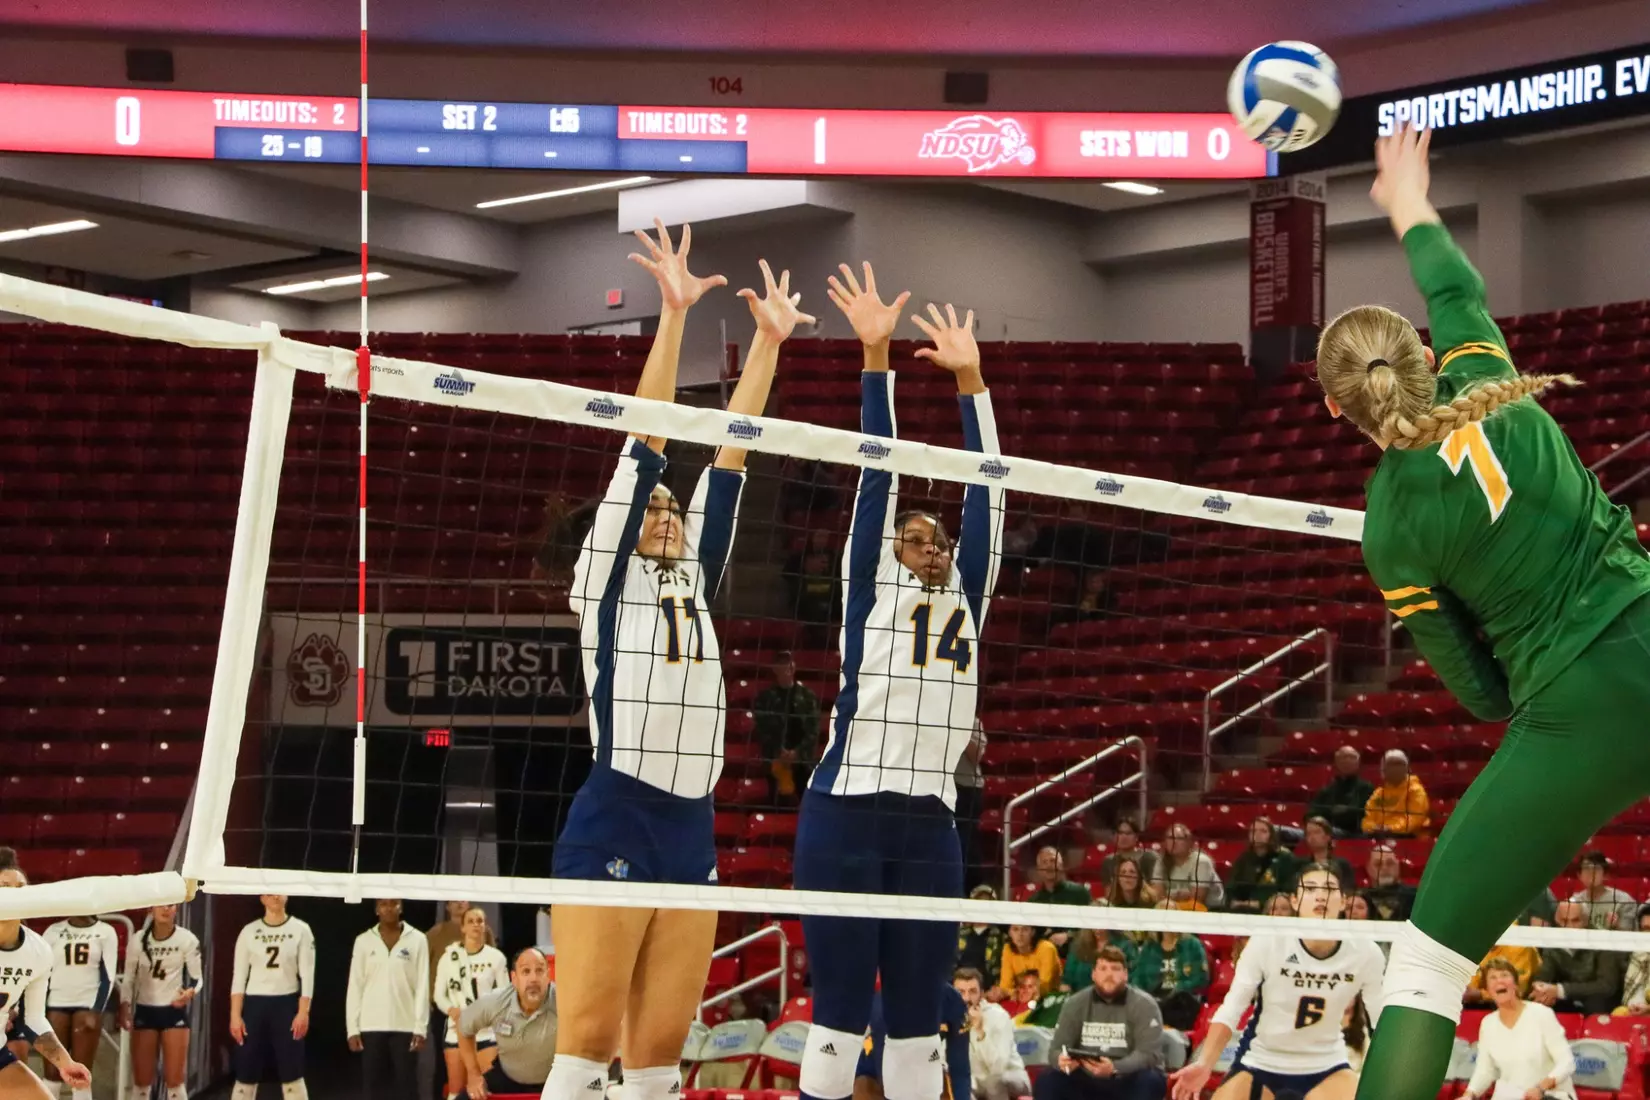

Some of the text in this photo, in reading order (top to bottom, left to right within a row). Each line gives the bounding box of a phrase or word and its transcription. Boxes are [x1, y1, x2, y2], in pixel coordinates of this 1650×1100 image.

[708, 77, 743, 95] 104
[212, 98, 345, 125] TIMEOUTS: 2
[1378, 64, 1607, 137] SPORTSMANSHIP.
[115, 96, 140, 146] 0
[442, 104, 497, 131] SET 2
[628, 110, 748, 136] TIMEOUTS: 2
[813, 117, 827, 165] 1
[918, 132, 1001, 159] NDSU
[1079, 127, 1231, 161] SETS WON 0
[1254, 211, 1276, 326] BASKETBALL
[434, 377, 476, 393] SUMMIT
[585, 401, 625, 416] SUMMIT
[727, 423, 763, 437] SUMMIT
[905, 602, 972, 674] 14
[447, 641, 568, 673] FIRST
[447, 674, 567, 698] DAKOTA
[63, 942, 91, 966] 16
[265, 946, 280, 969] 2
[152, 959, 168, 981] 4
[1279, 967, 1355, 983] KANSAS
[1294, 979, 1338, 991] CITY
[1294, 995, 1326, 1030] 6
